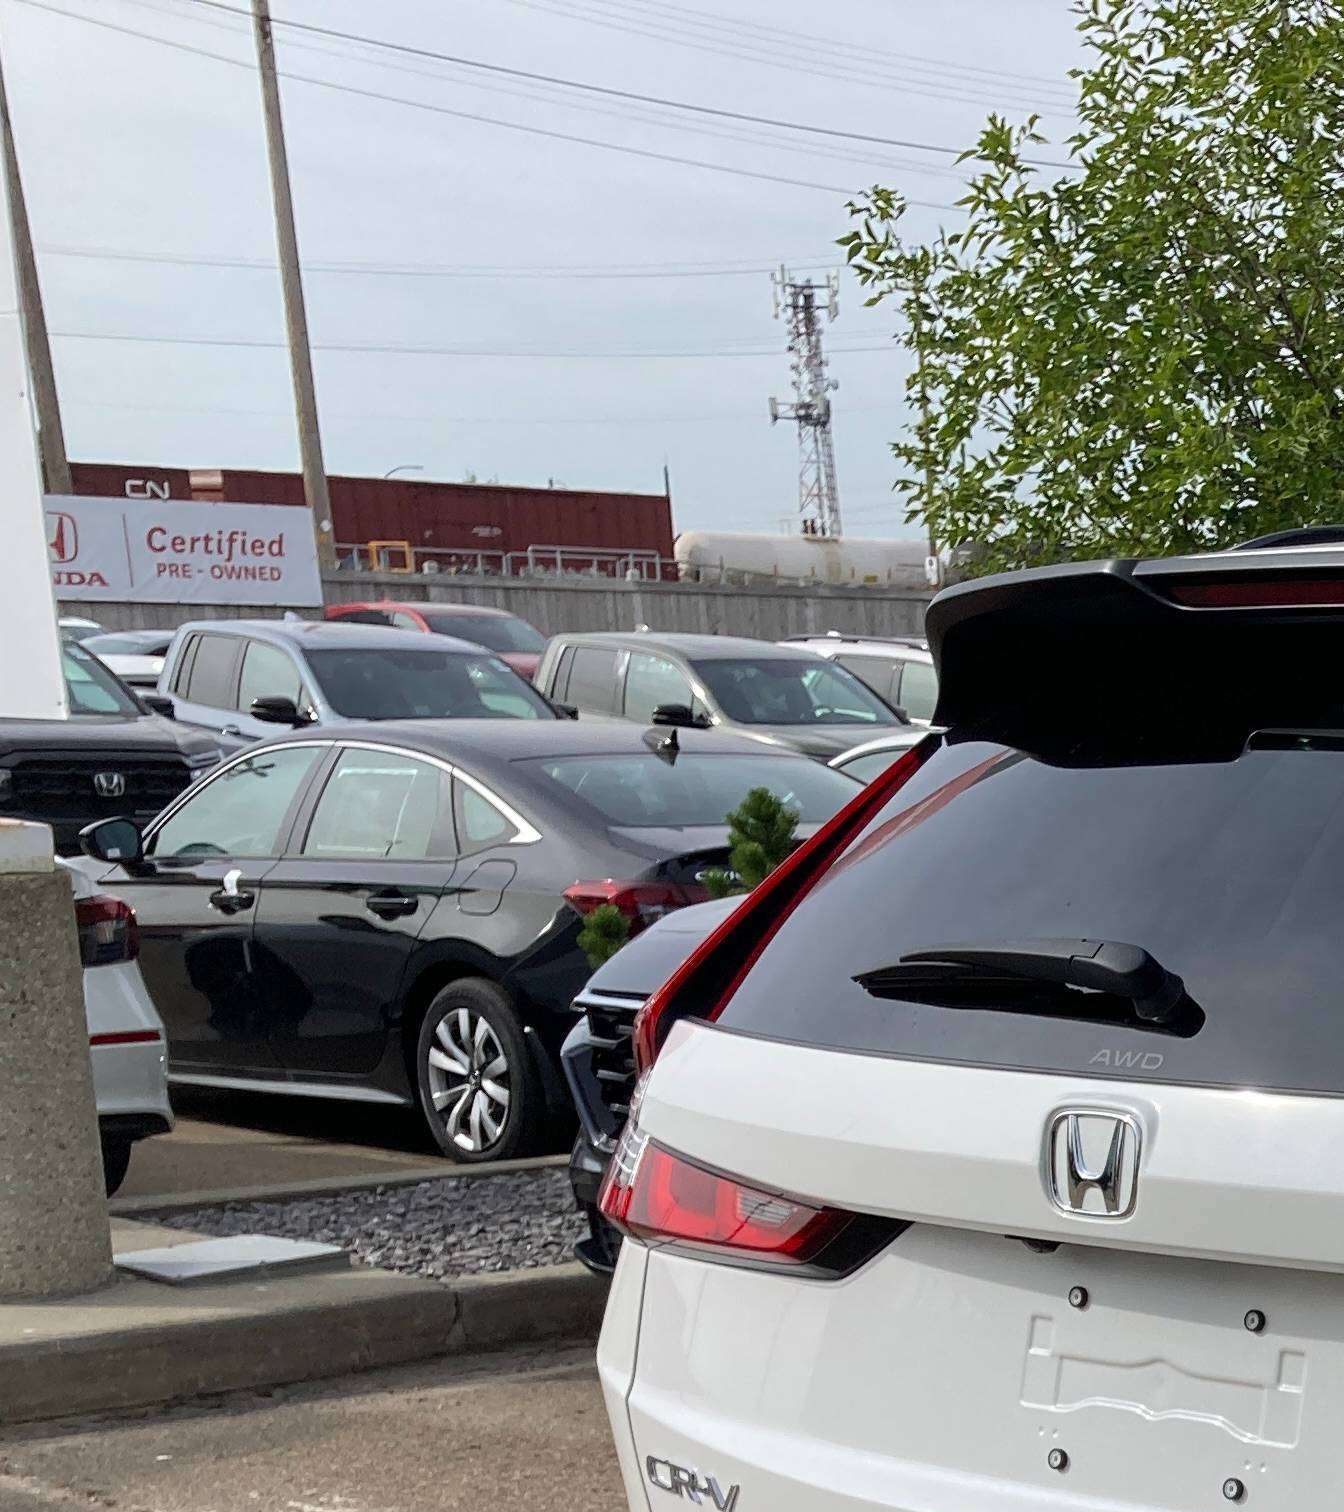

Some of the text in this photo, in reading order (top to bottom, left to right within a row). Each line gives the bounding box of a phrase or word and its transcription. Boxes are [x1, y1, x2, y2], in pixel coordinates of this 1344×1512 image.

[125, 478, 170, 500] CN
[146, 526, 286, 562] Certified
[1088, 1049, 1164, 1070] AWD
